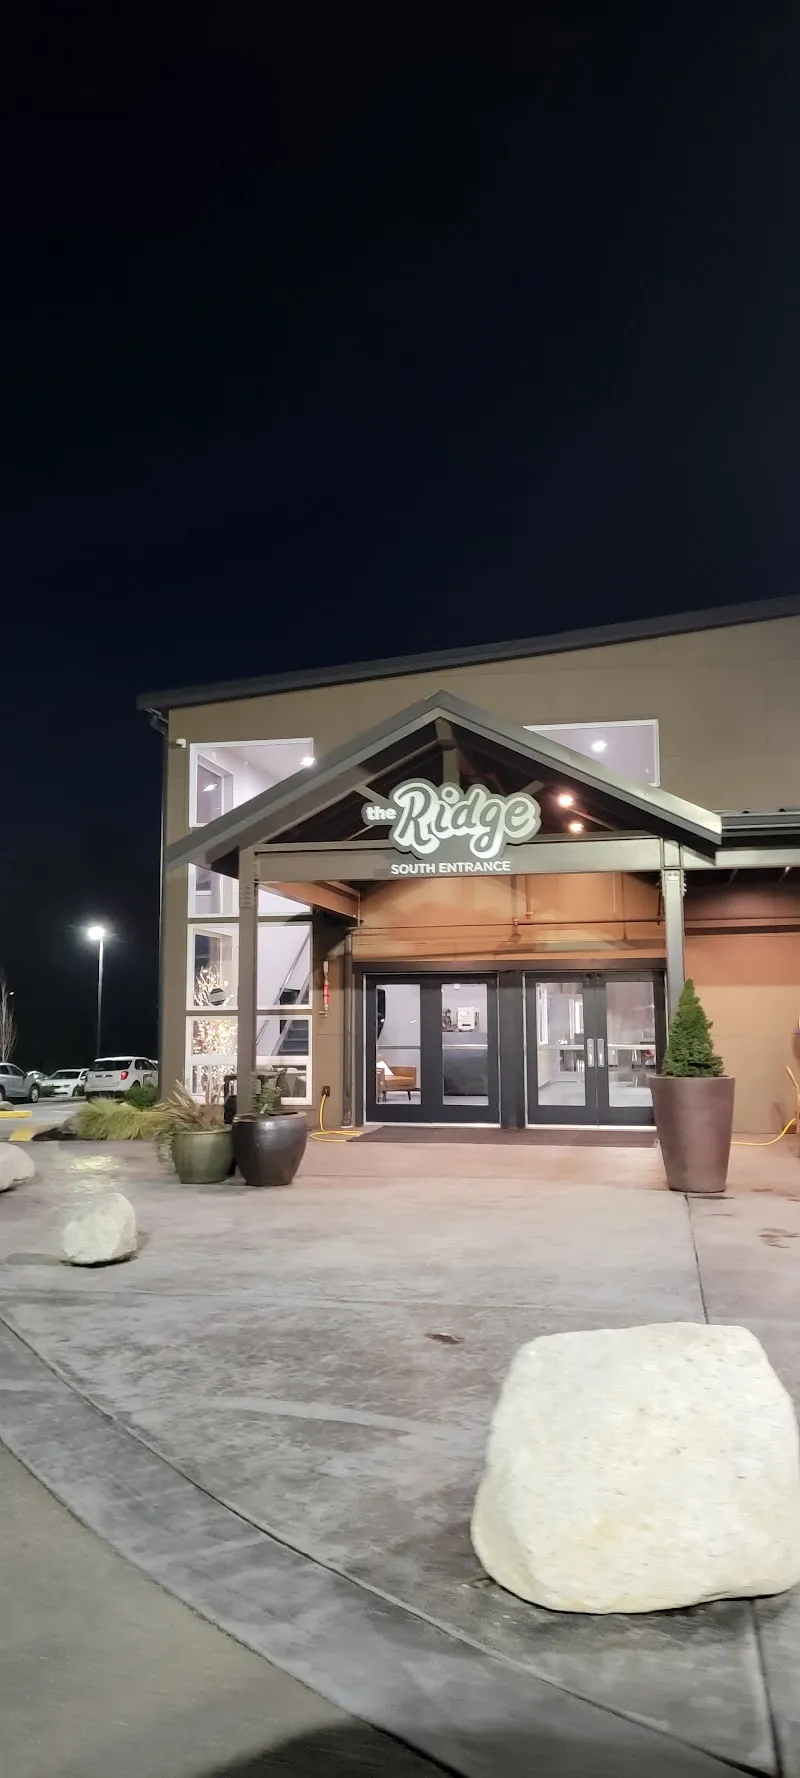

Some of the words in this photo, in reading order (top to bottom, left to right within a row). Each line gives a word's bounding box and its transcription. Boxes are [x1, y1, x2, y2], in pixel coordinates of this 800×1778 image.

[365, 805, 397, 821] the
[393, 782, 536, 859] Ridge
[391, 863, 436, 875] SOUTH
[439, 861, 511, 873] ENTRANCE
